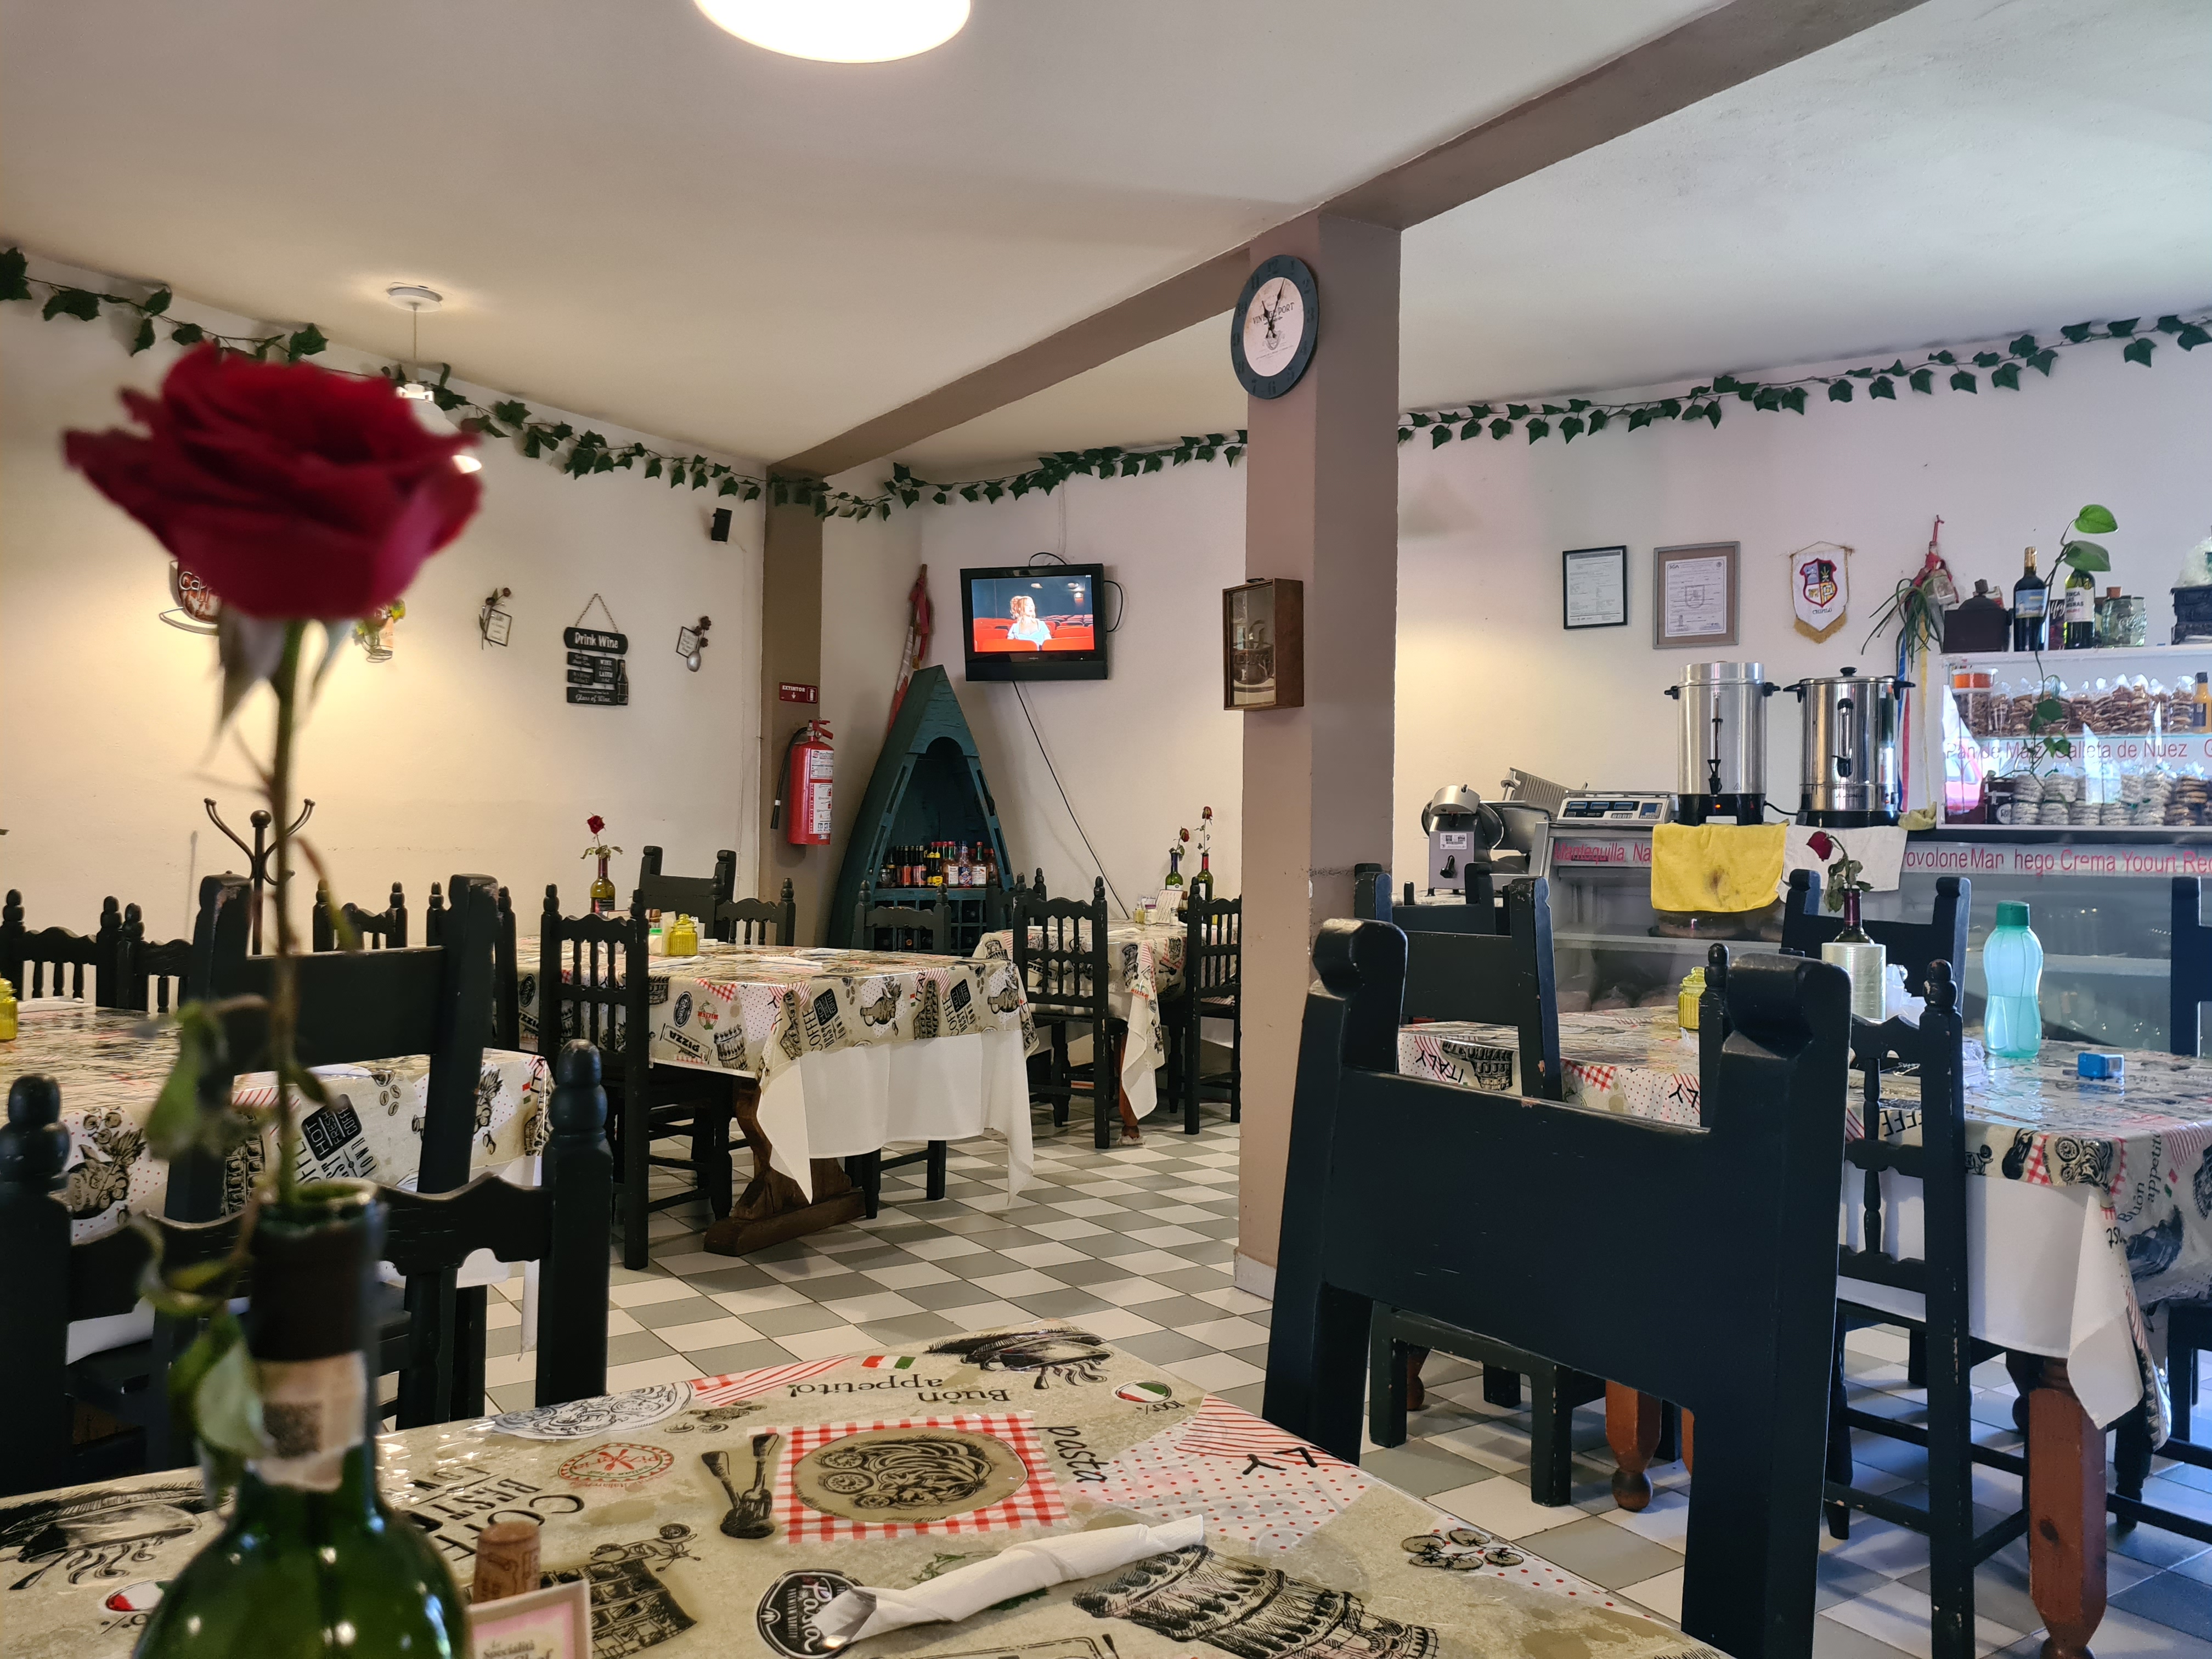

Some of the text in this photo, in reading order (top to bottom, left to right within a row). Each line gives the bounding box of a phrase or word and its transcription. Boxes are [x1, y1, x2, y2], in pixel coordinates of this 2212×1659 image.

[1278, 302, 1295, 315] PORT
[575, 631, 619, 649] Drink Wine
[2117, 740, 2137, 759] de
[2143, 742, 2188, 758] Nuez
[1554, 842, 1625, 865] Mantequilla
[815, 1002, 826, 1024] HOT
[669, 1030, 701, 1053] PIZZA
[821, 1024, 836, 1048] BEST
[1415, 1050, 1464, 1084] ITALY
[306, 1122, 330, 1157] HOT
[790, 1374, 943, 1397] appetito!
[918, 1389, 1011, 1404] Buon
[1028, 1425, 1109, 1483] pasta
[430, 1478, 544, 1521] BEST
